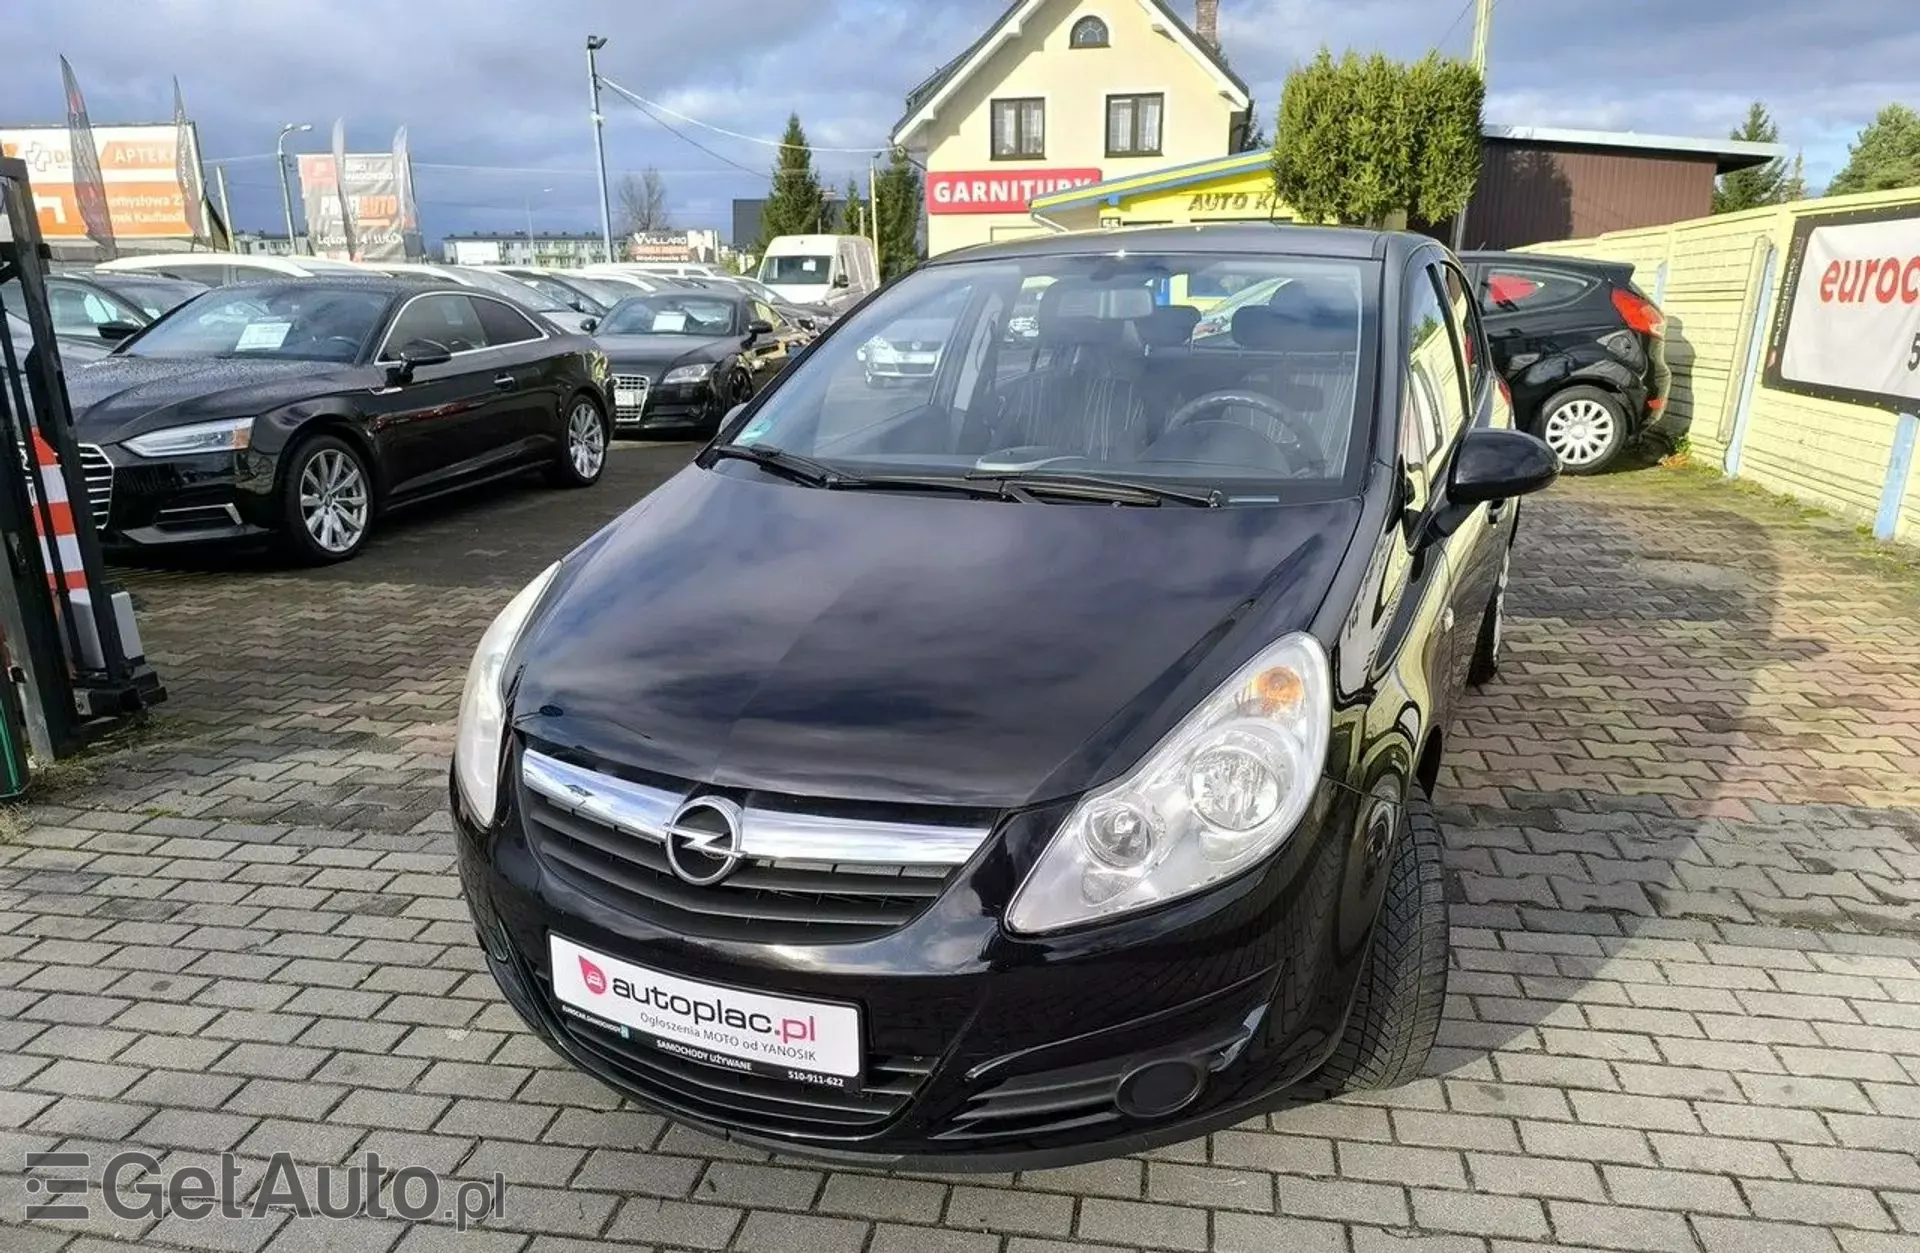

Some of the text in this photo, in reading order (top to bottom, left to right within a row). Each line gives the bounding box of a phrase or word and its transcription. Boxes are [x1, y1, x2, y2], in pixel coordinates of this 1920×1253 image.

[1187, 193, 1248, 211] AUTO
[611, 976, 817, 1044] autoplac.pl
[640, 1012, 817, 1062] Ogłoszenia MOTO od YANOSIK
[656, 1039, 753, 1071] SAMOCHODY UŻYWANE
[787, 1070, 845, 1088] 510-911-622
